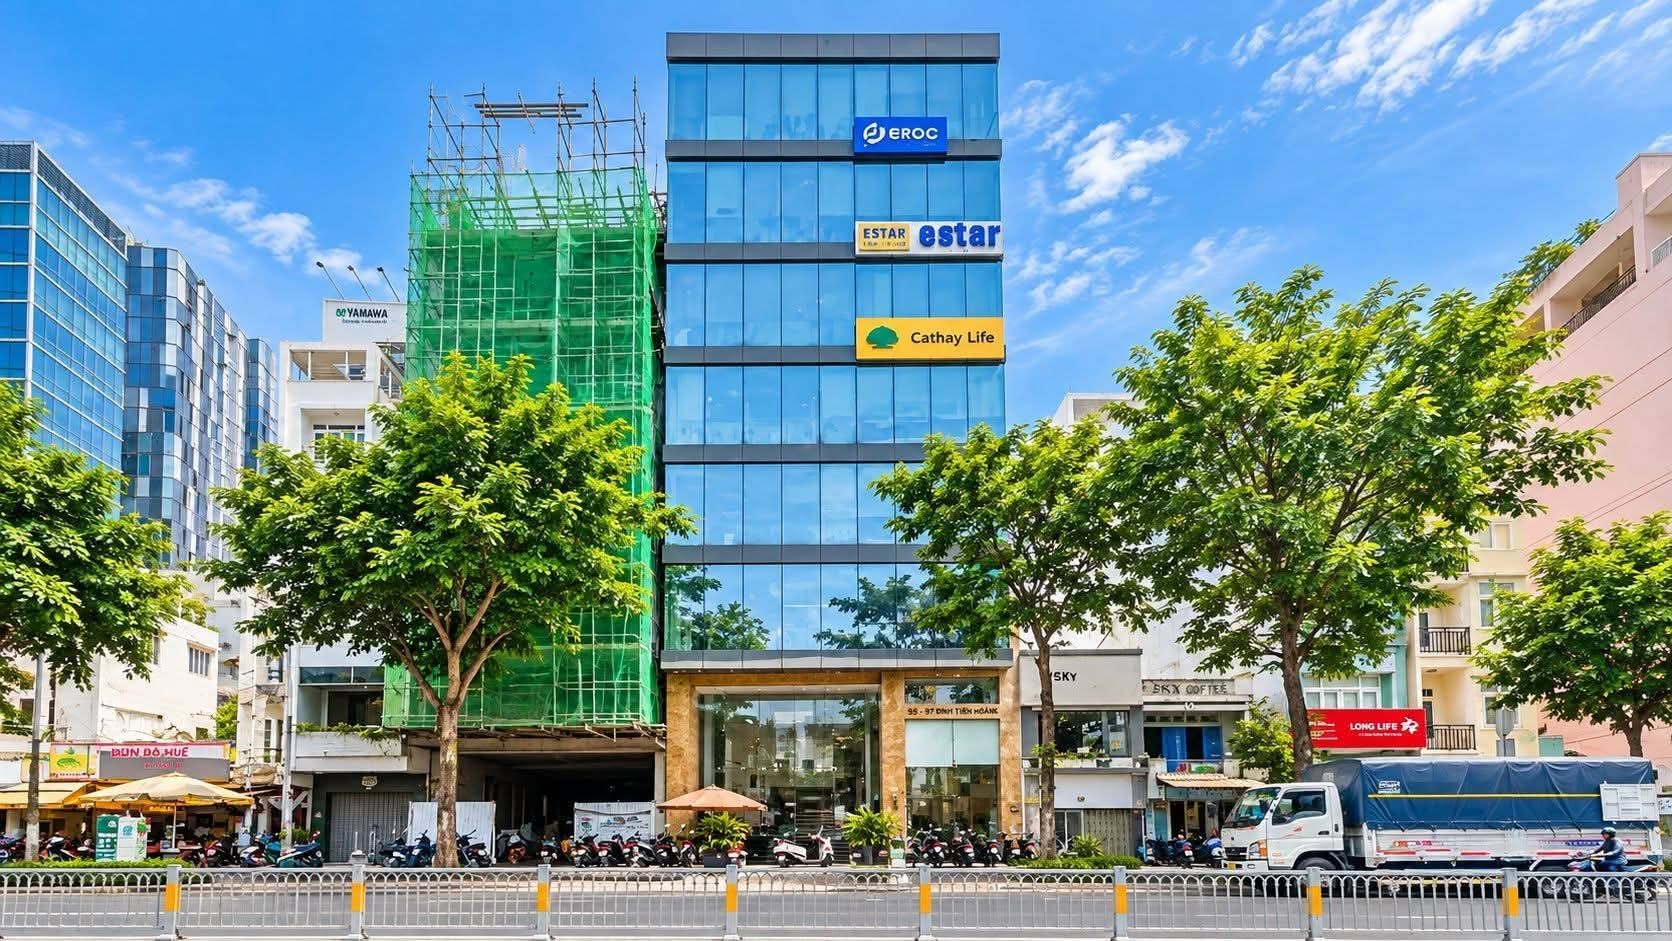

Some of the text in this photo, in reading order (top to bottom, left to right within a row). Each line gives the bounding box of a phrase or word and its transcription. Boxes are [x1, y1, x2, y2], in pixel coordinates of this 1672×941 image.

[888, 127, 939, 140] EROC
[863, 227, 906, 239] ESTAR
[919, 222, 1001, 248] estar
[347, 308, 388, 318] YAMAWA
[910, 331, 995, 347] Cathay Life
[1050, 671, 1077, 681] SKY
[1349, 722, 1398, 731] LONG LIFE
